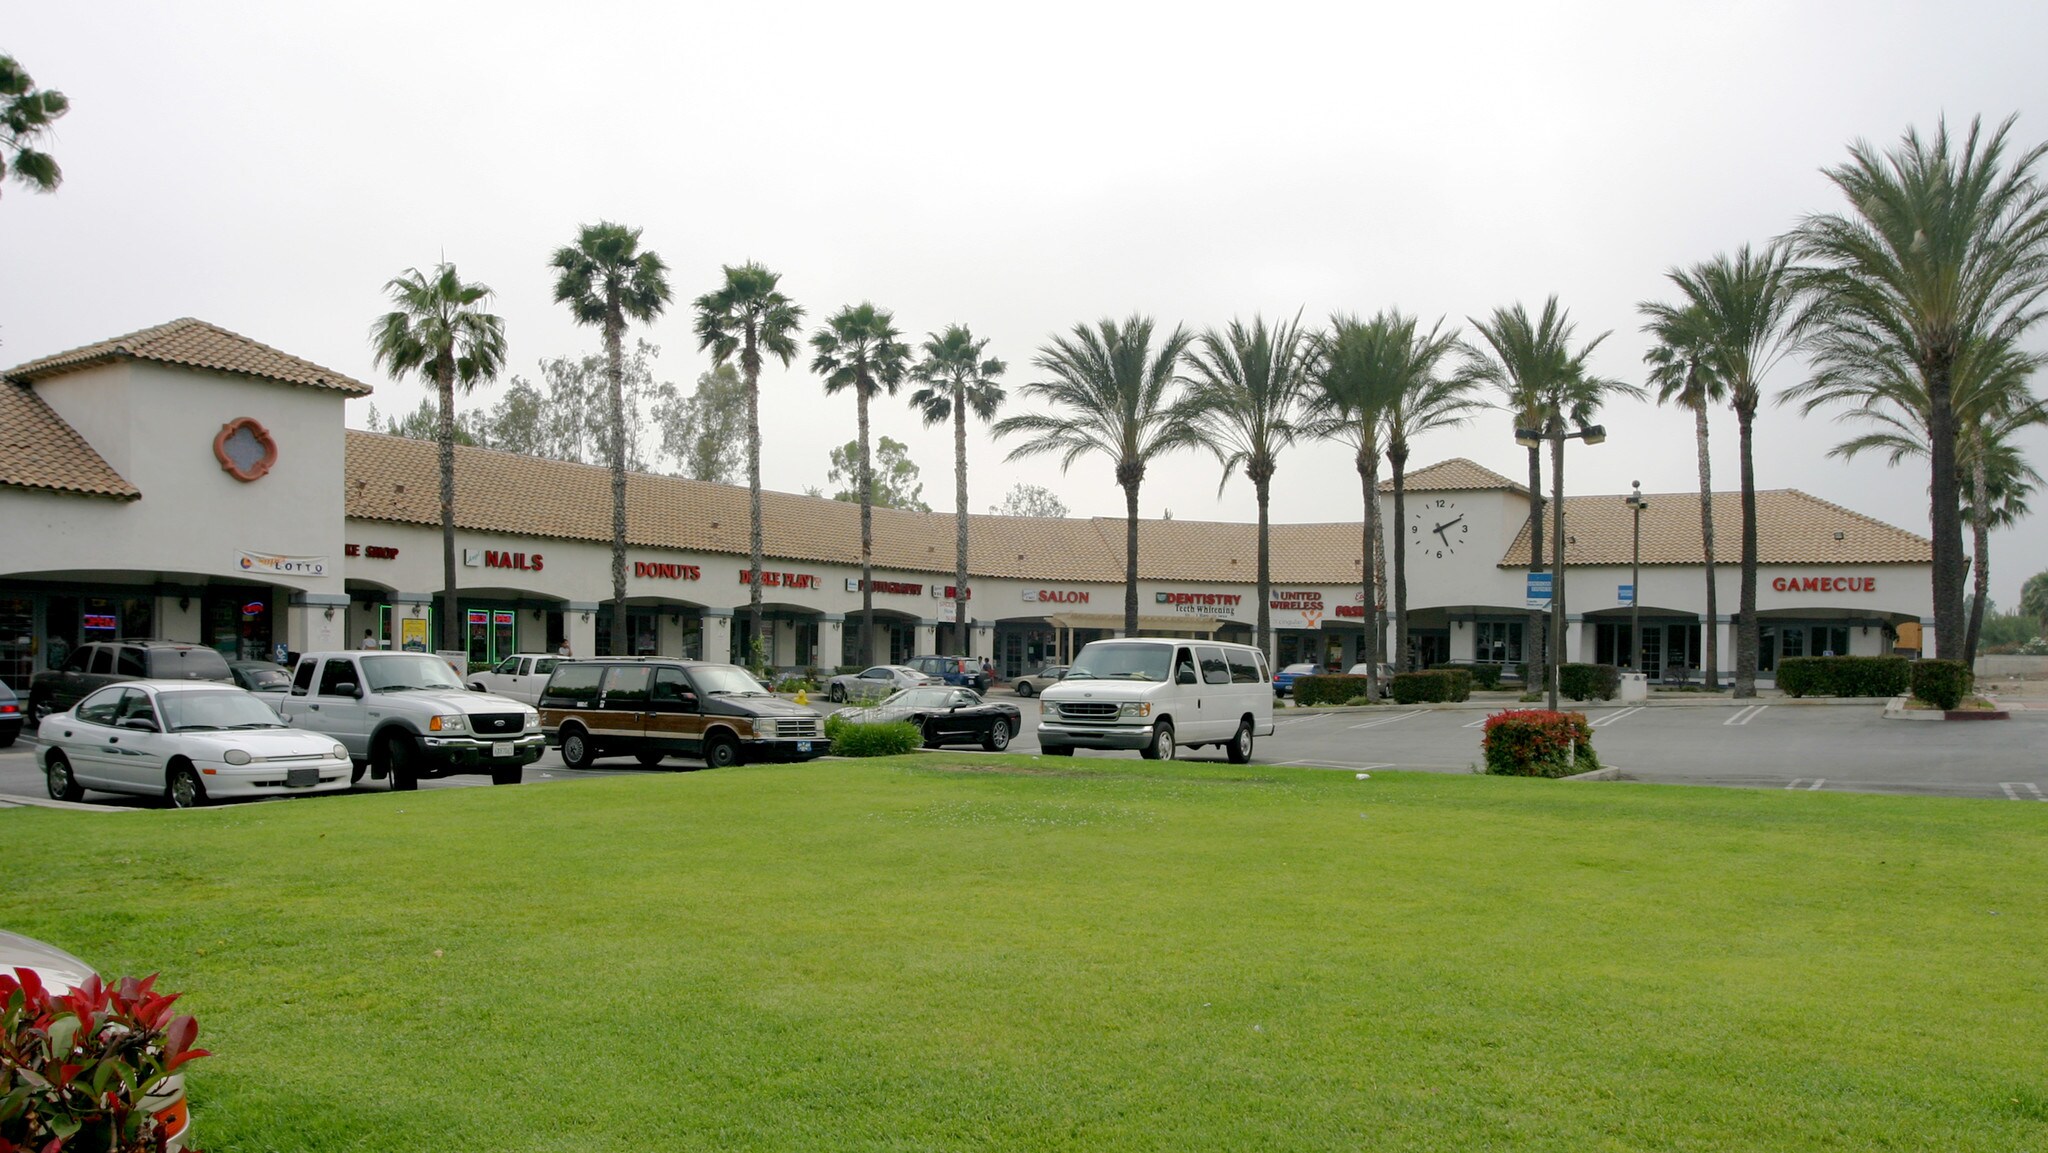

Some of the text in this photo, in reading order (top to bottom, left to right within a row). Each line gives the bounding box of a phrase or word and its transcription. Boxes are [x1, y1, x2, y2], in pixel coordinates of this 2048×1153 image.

[1436, 499, 1445, 508] 12
[1411, 525, 1418, 534] 9
[1462, 524, 1468, 533] 3
[364, 545, 399, 560] SHOP
[1436, 550, 1443, 559] 6
[485, 550, 544, 571] NAILS
[275, 562, 323, 573] LOTTO
[634, 561, 701, 581] DONUTS
[739, 570, 780, 586] DBLE
[782, 573, 813, 588] PLAY
[1772, 577, 1876, 592] GAMECUE
[858, 580, 923, 595] POTOGRAPHY
[1039, 590, 1090, 603] SALON
[1167, 593, 1241, 605] DENTISTRY
[1280, 592, 1322, 600] UNITED
[1175, 604, 1195, 612] Teeth
[1197, 605, 1235, 616] Whitening
[1270, 601, 1324, 610] WIRELESS
